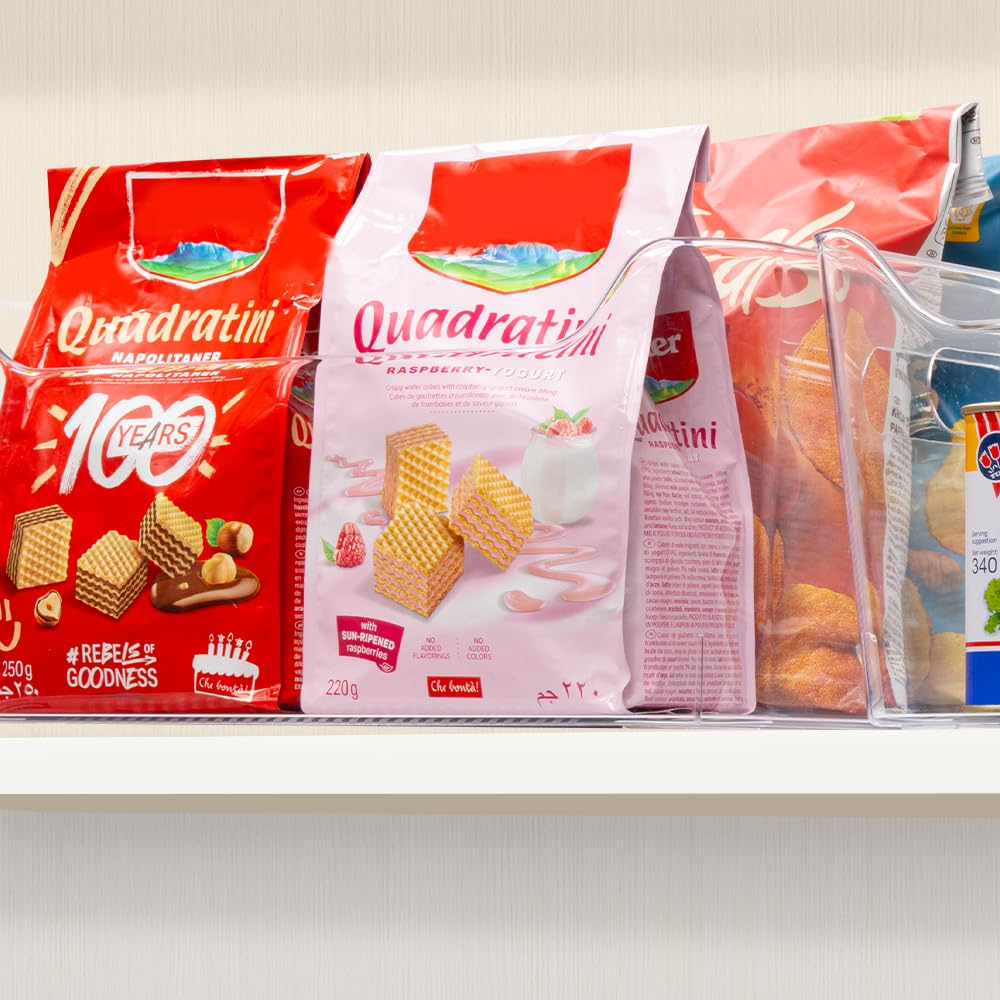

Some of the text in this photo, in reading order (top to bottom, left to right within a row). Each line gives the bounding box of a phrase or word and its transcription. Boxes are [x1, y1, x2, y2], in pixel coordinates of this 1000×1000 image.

[57, 300, 280, 355] Quadratini
[111, 352, 222, 364] NAPOLITANER
[116, 422, 191, 450] YEARS
[360, 621, 378, 632] with
[341, 630, 395, 650] SUN-RIPENED
[143, 643, 156, 653] OF
[346, 644, 388, 660] raspberries
[66, 666, 158, 690] GOODNESS
[199, 678, 213, 691] Che
[430, 680, 480, 694] Che bontà!
